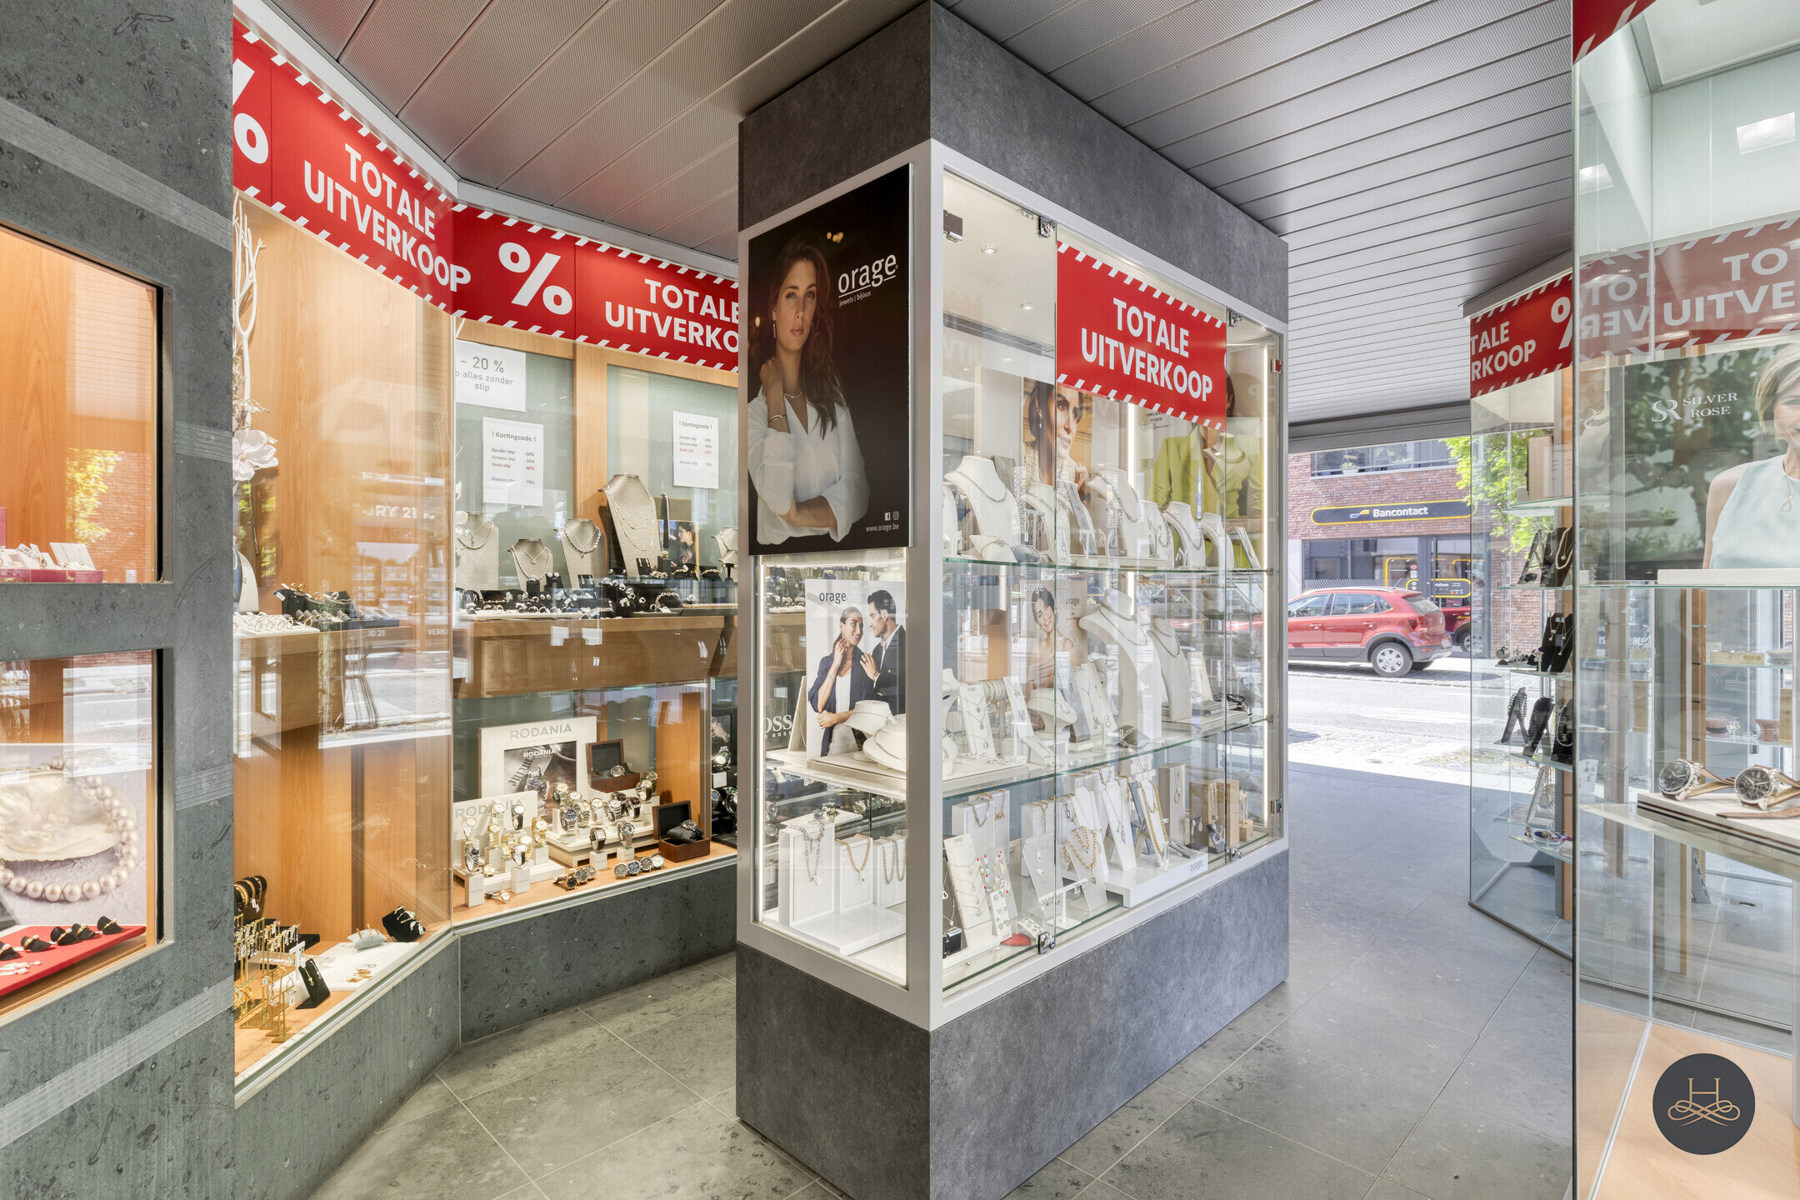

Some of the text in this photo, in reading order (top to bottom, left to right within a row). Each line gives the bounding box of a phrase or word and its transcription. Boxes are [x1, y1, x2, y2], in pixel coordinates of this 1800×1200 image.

[345, 143, 436, 241] TOTALE
[304, 160, 472, 292] UITVERKOOP
[498, 241, 573, 315] %
[838, 254, 897, 288] orage
[644, 278, 738, 324] TOTALE
[1113, 297, 1190, 358] TOTALE
[472, 356, 489, 370] 20
[1081, 327, 1213, 402] UITVERKOOP
[462, 370, 484, 381] alles
[485, 374, 514, 386] zonder
[474, 383, 490, 393] stip
[1683, 392, 1738, 407] SILVER
[1691, 406, 1731, 418] ROSE
[495, 431, 533, 442] Kortingcode
[1372, 506, 1429, 518] Bancontact
[819, 592, 847, 605] orage
[510, 723, 573, 740] RODANIA
[523, 748, 556, 758] RODANIA
